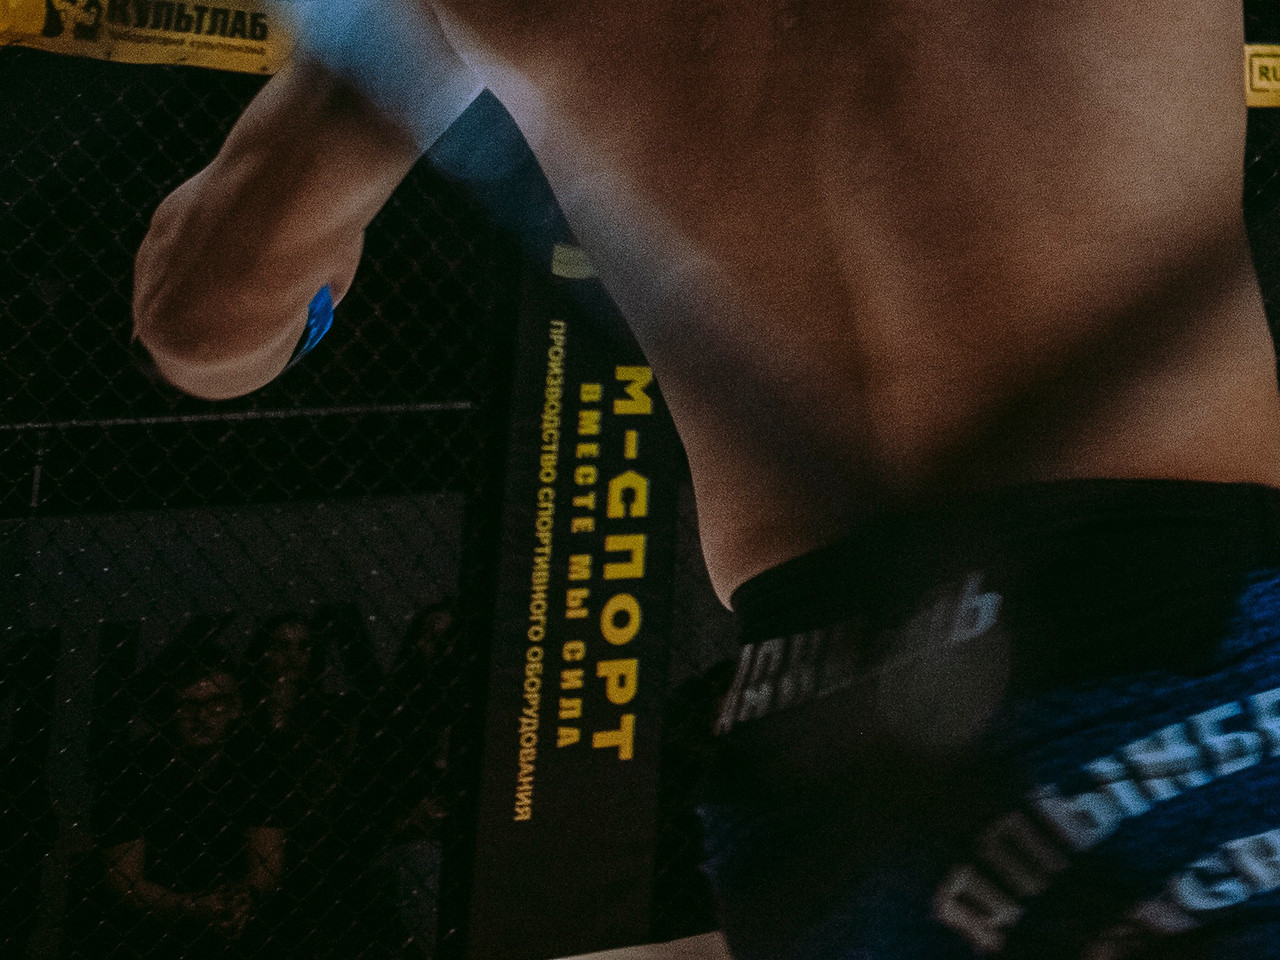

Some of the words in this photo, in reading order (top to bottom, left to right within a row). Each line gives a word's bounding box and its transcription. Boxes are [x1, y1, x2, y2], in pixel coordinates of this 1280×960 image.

[537, 319, 568, 484] ПРОИЗВОДСТВО
[570, 382, 603, 534] ВМЕСТЕ
[526, 486, 556, 642] СПОРТИВНОГО
[564, 553, 593, 619] МЫ
[591, 364, 653, 761] М-СПОРТ
[513, 645, 545, 822] ОБОРУДОВАНИЯ
[556, 639, 586, 748] СИЛА
